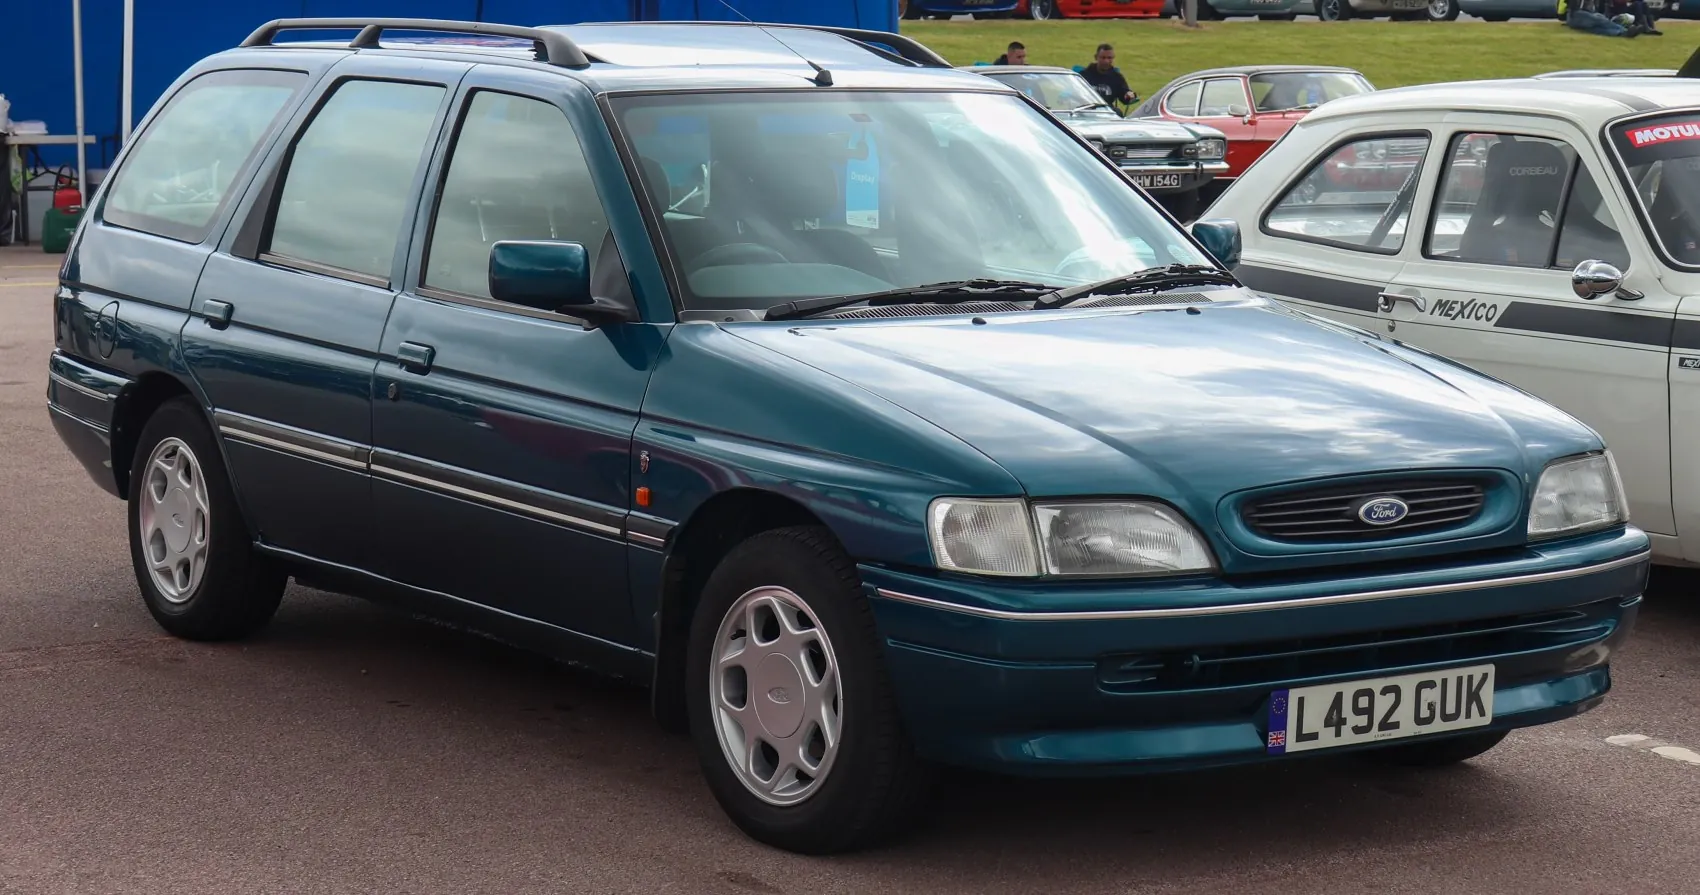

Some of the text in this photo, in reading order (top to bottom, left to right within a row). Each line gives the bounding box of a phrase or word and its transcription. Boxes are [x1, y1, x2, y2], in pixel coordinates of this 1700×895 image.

[850, 171, 876, 185] Display
[1509, 166, 1558, 176] CORBEAU
[1153, 174, 1178, 186] 154G
[1429, 298, 1498, 322] MEXICO
[1371, 503, 1398, 519] Ford
[1295, 672, 1489, 743] L492 GUK
